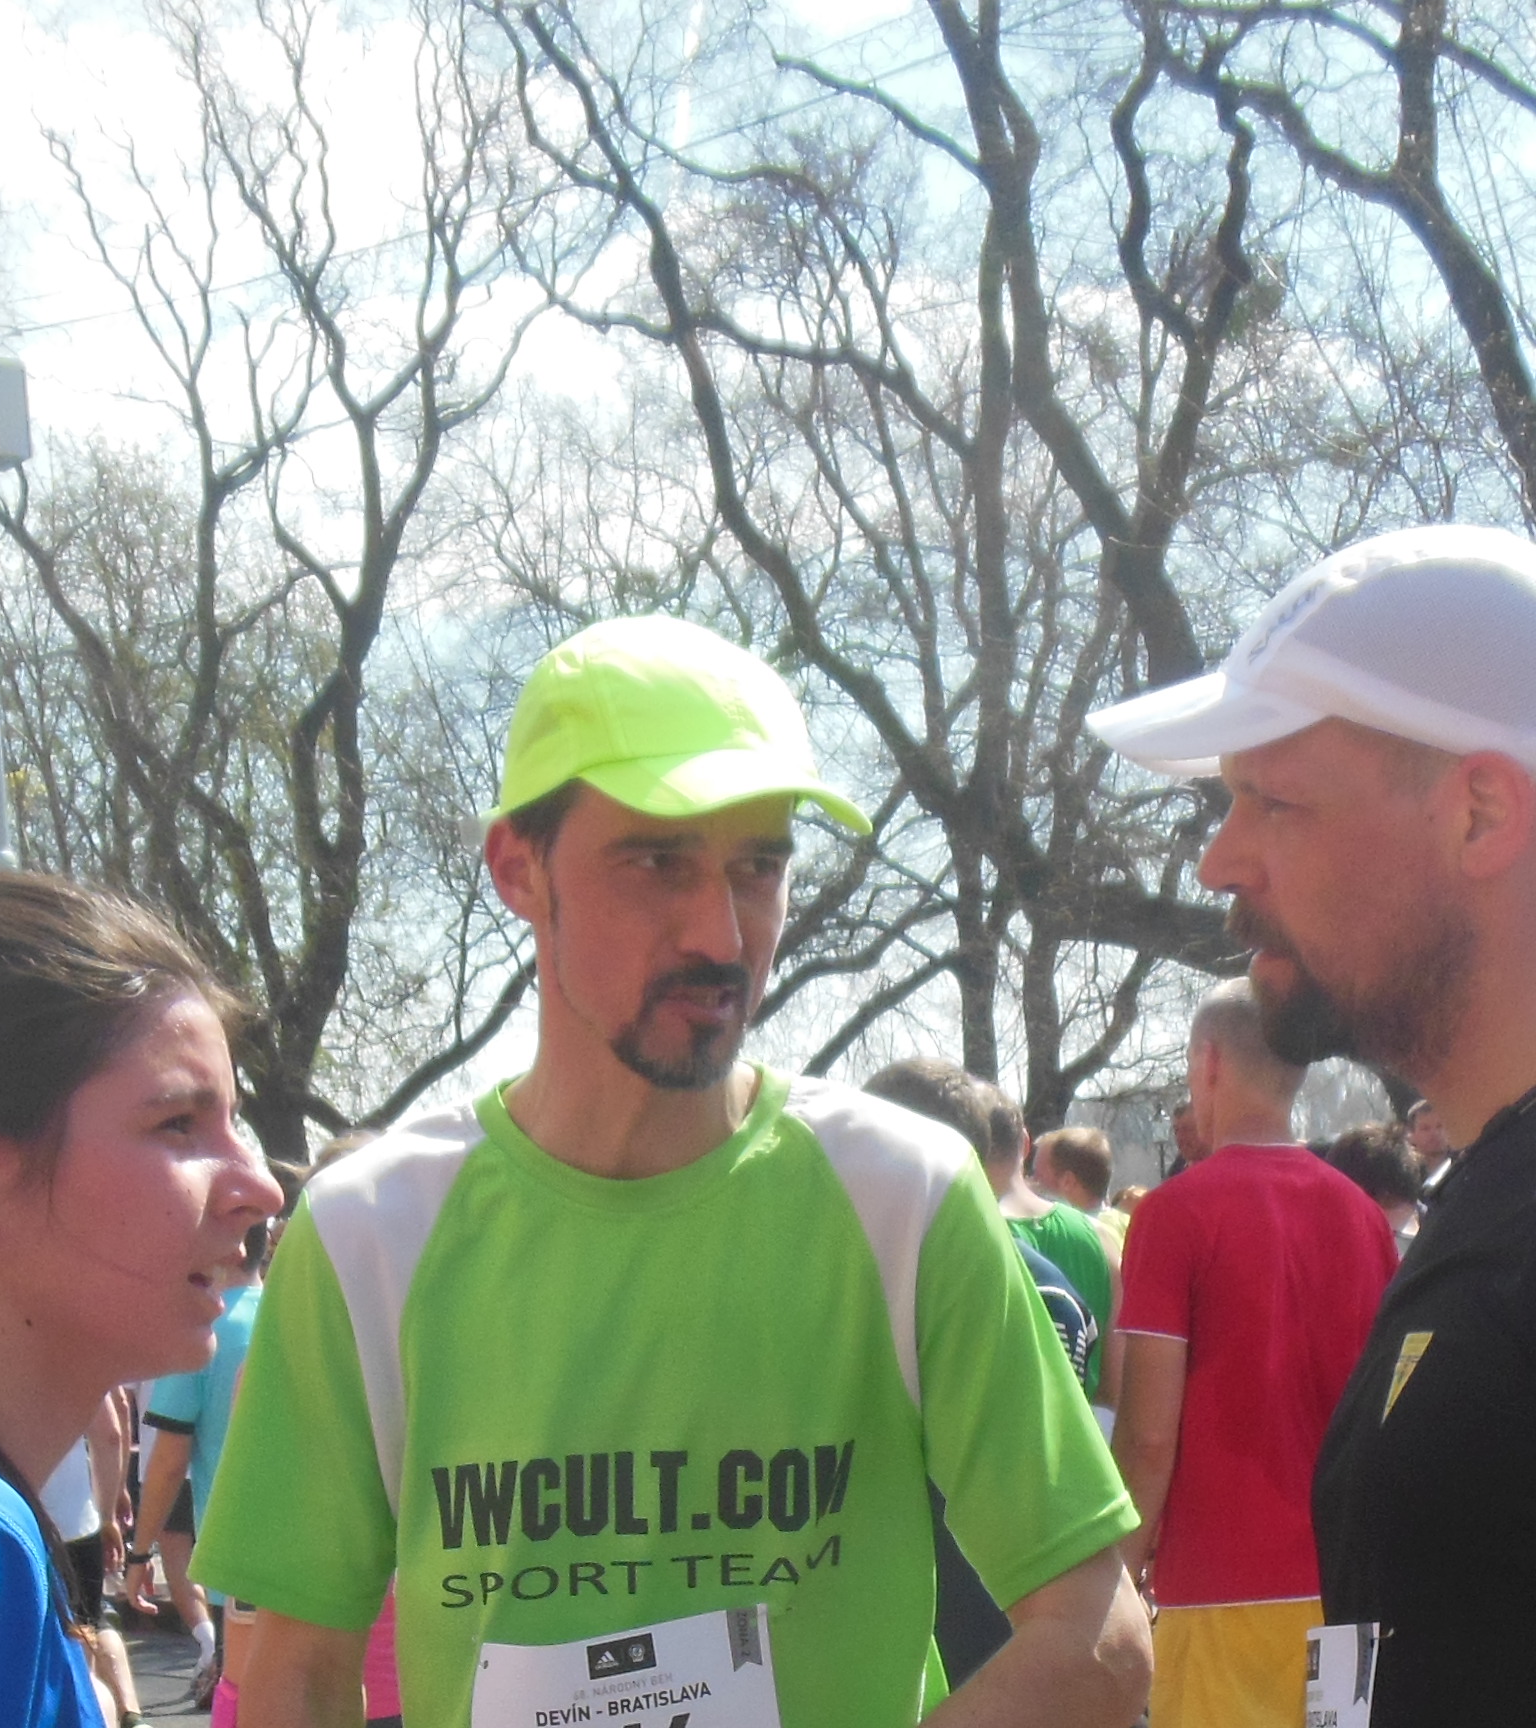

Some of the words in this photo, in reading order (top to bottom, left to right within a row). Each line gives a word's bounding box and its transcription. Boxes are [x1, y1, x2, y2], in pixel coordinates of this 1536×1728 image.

[441, 1560, 654, 1609] SPORT
[536, 1704, 591, 1727] DEVÍN
[608, 1681, 712, 1717] BRATISLAVA
